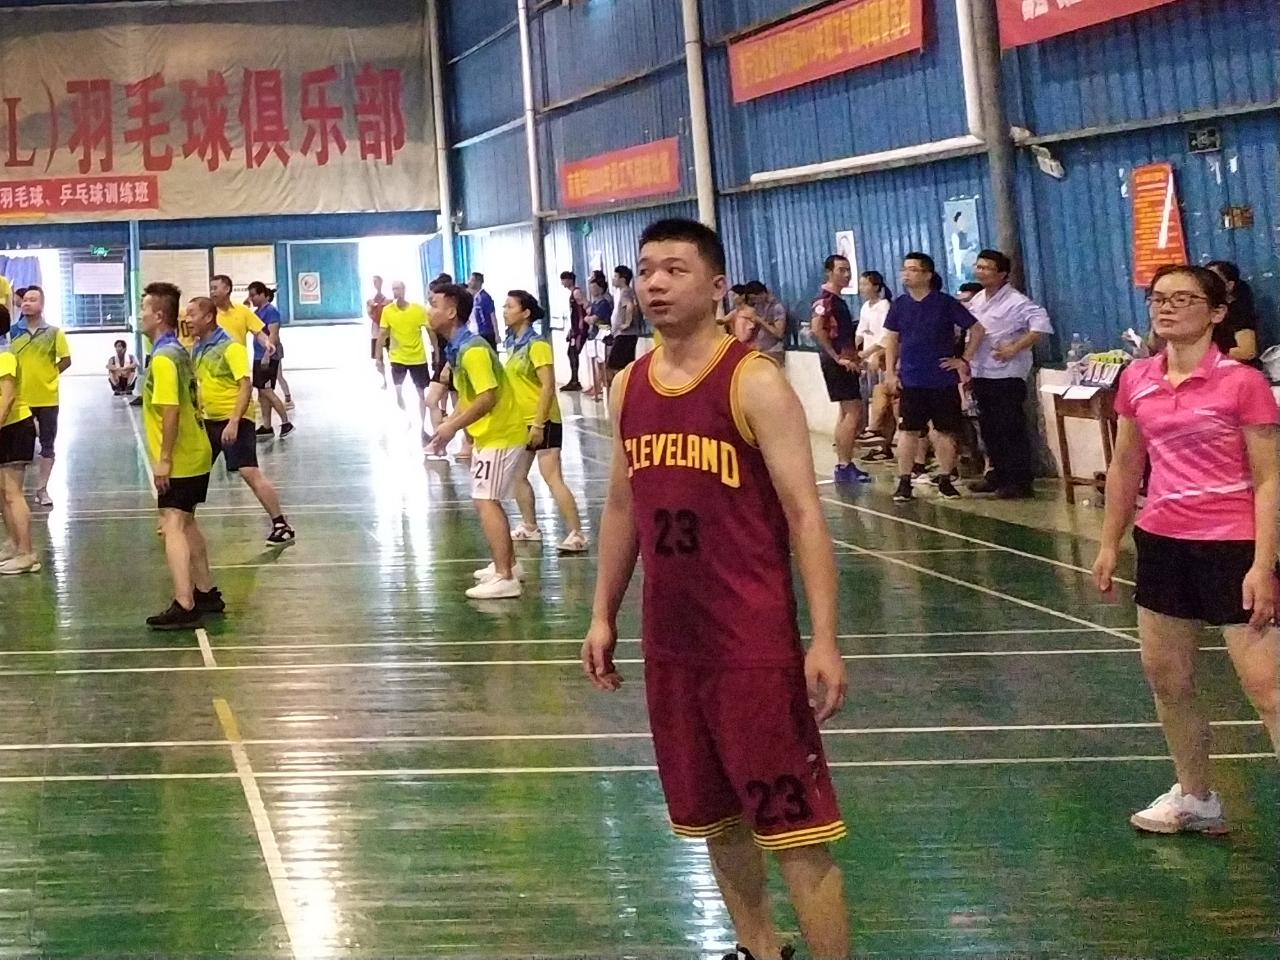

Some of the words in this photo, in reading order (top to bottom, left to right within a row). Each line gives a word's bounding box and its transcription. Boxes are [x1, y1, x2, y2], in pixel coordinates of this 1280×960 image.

[474, 460, 491, 480] 21
[654, 508, 699, 555] 23
[746, 773, 813, 827] 23
